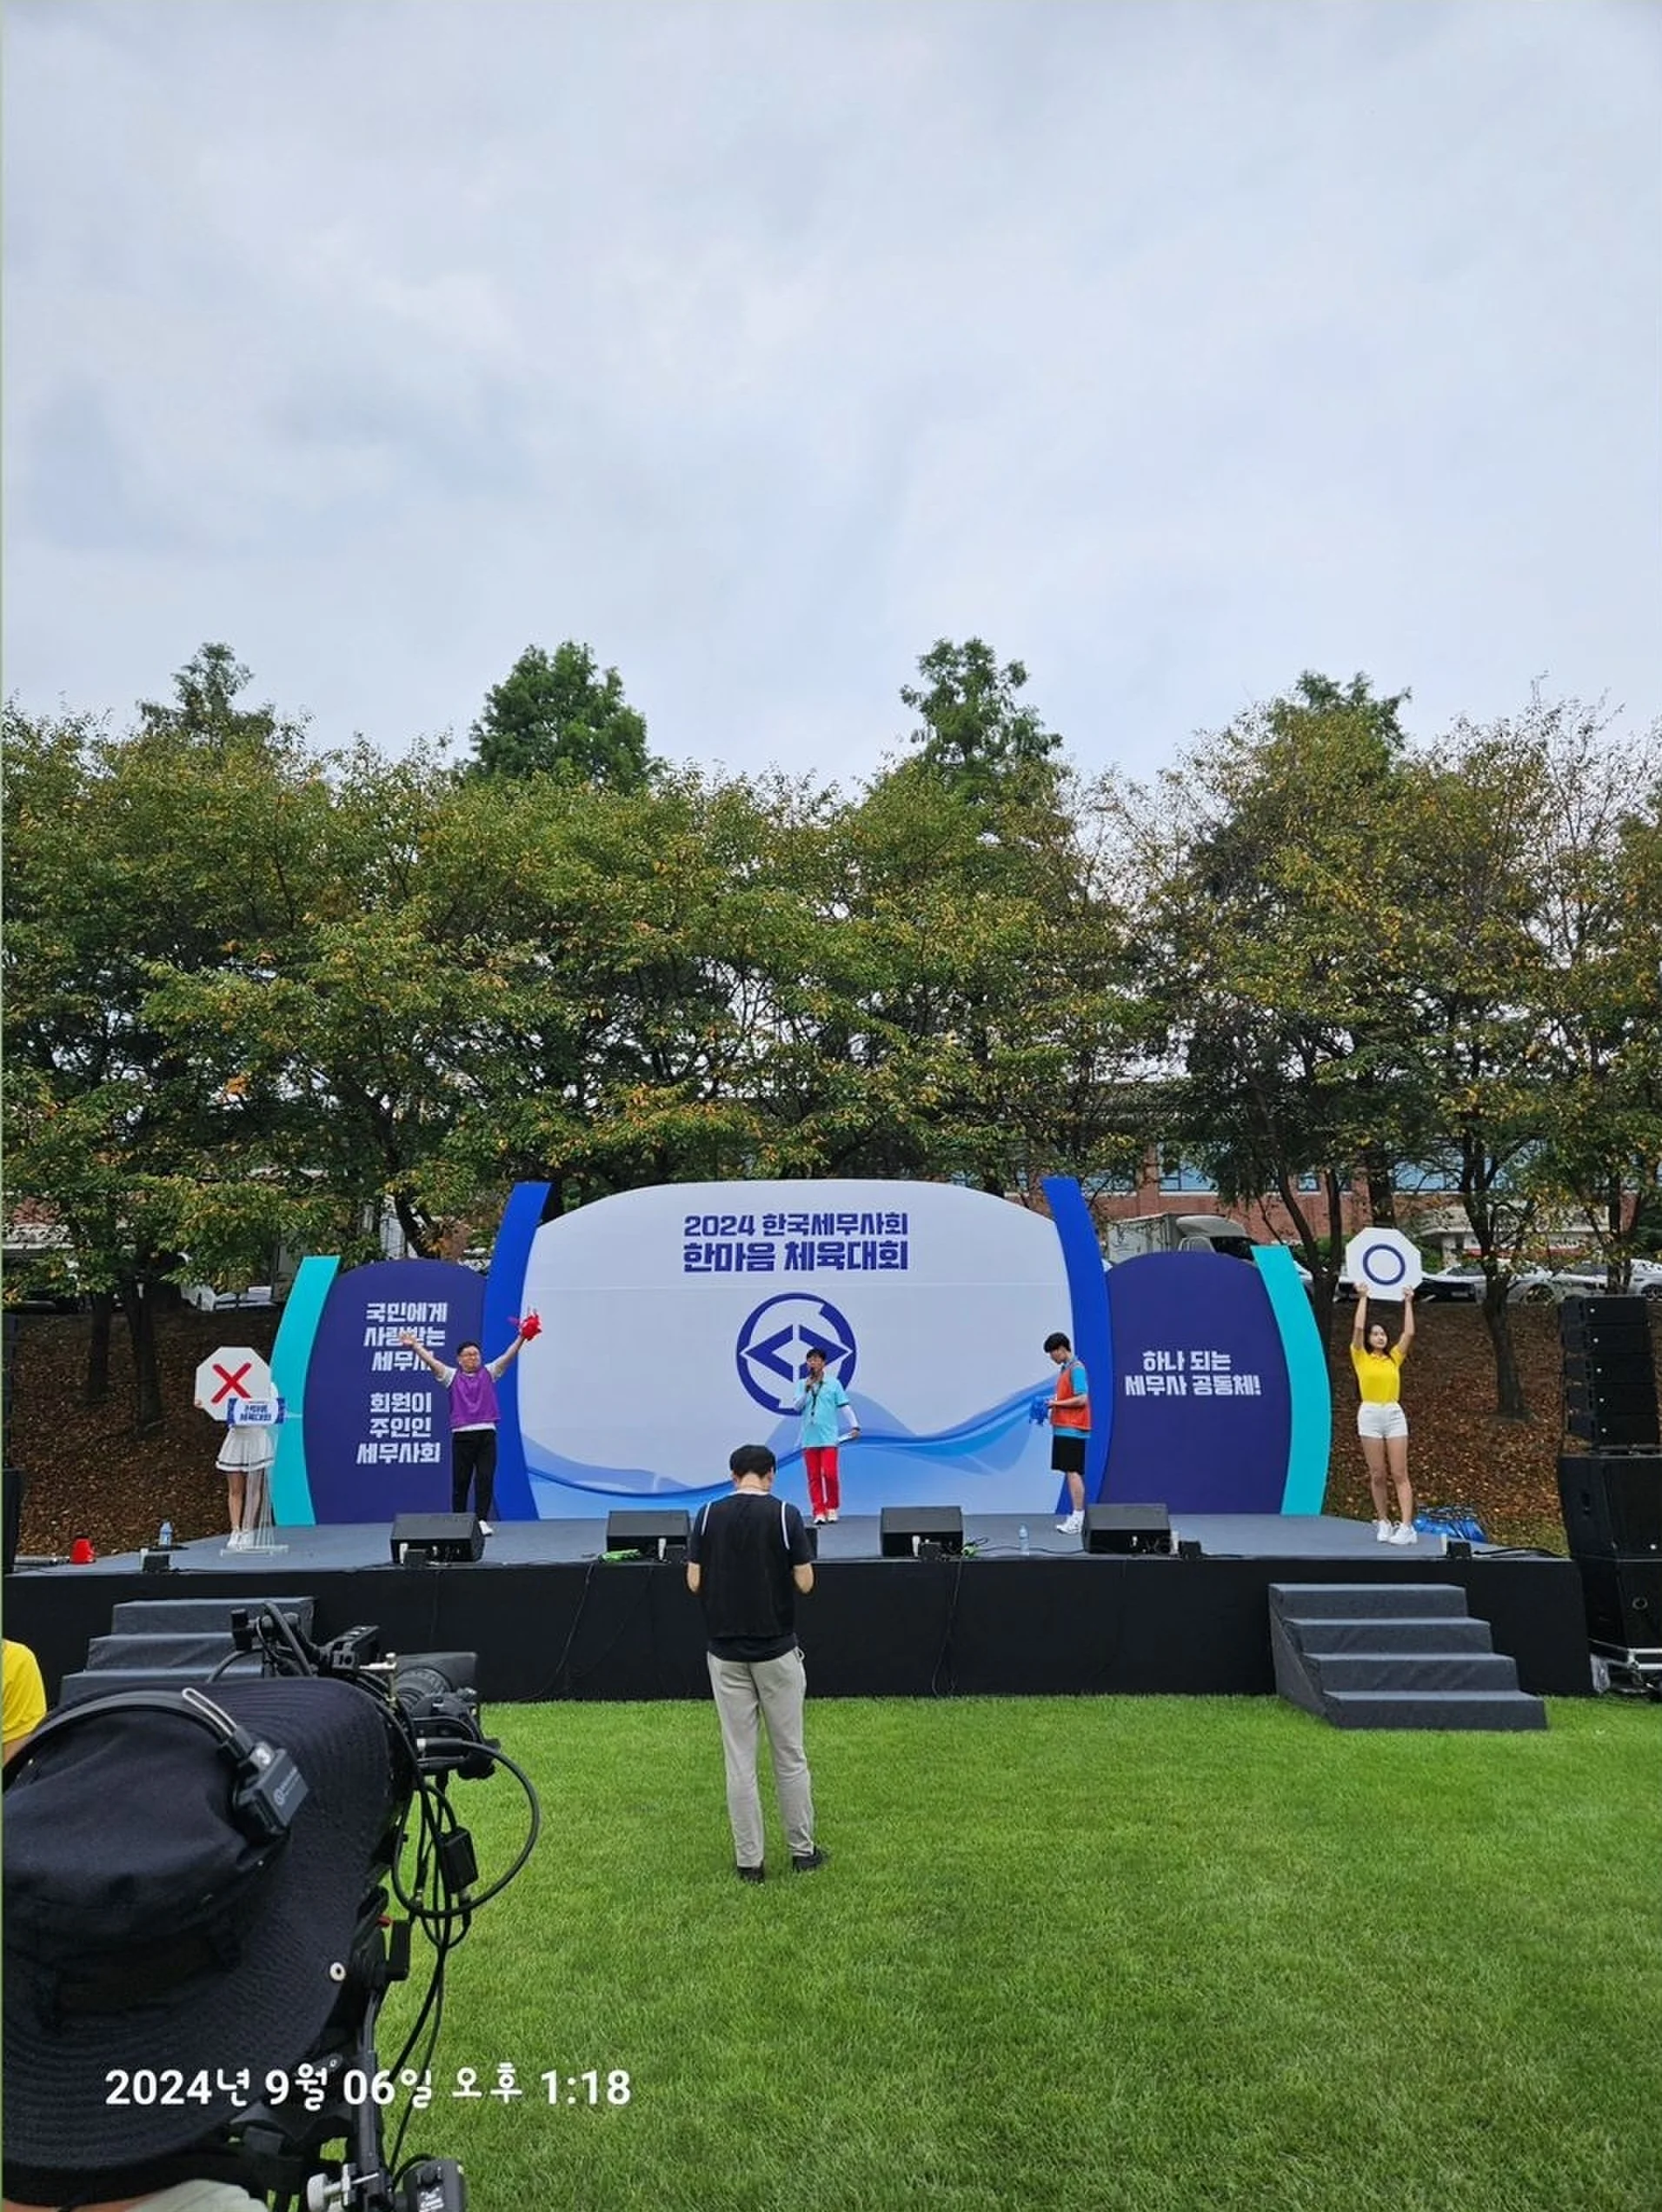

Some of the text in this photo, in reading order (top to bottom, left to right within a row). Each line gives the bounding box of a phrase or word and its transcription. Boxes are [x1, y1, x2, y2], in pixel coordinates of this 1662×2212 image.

[683, 1212, 908, 1236] 2024 한국세무사회
[683, 1240, 908, 1273] 한마음 체육대회
[366, 1302, 448, 1323] 국민에게
[1142, 1350, 1232, 1371] 하나 되는
[1125, 1374, 1261, 1396] 세무사 공동체!
[369, 1392, 432, 1413] 회원이
[369, 1417, 432, 1438] 주인인
[356, 1442, 441, 1464] 세무사회
